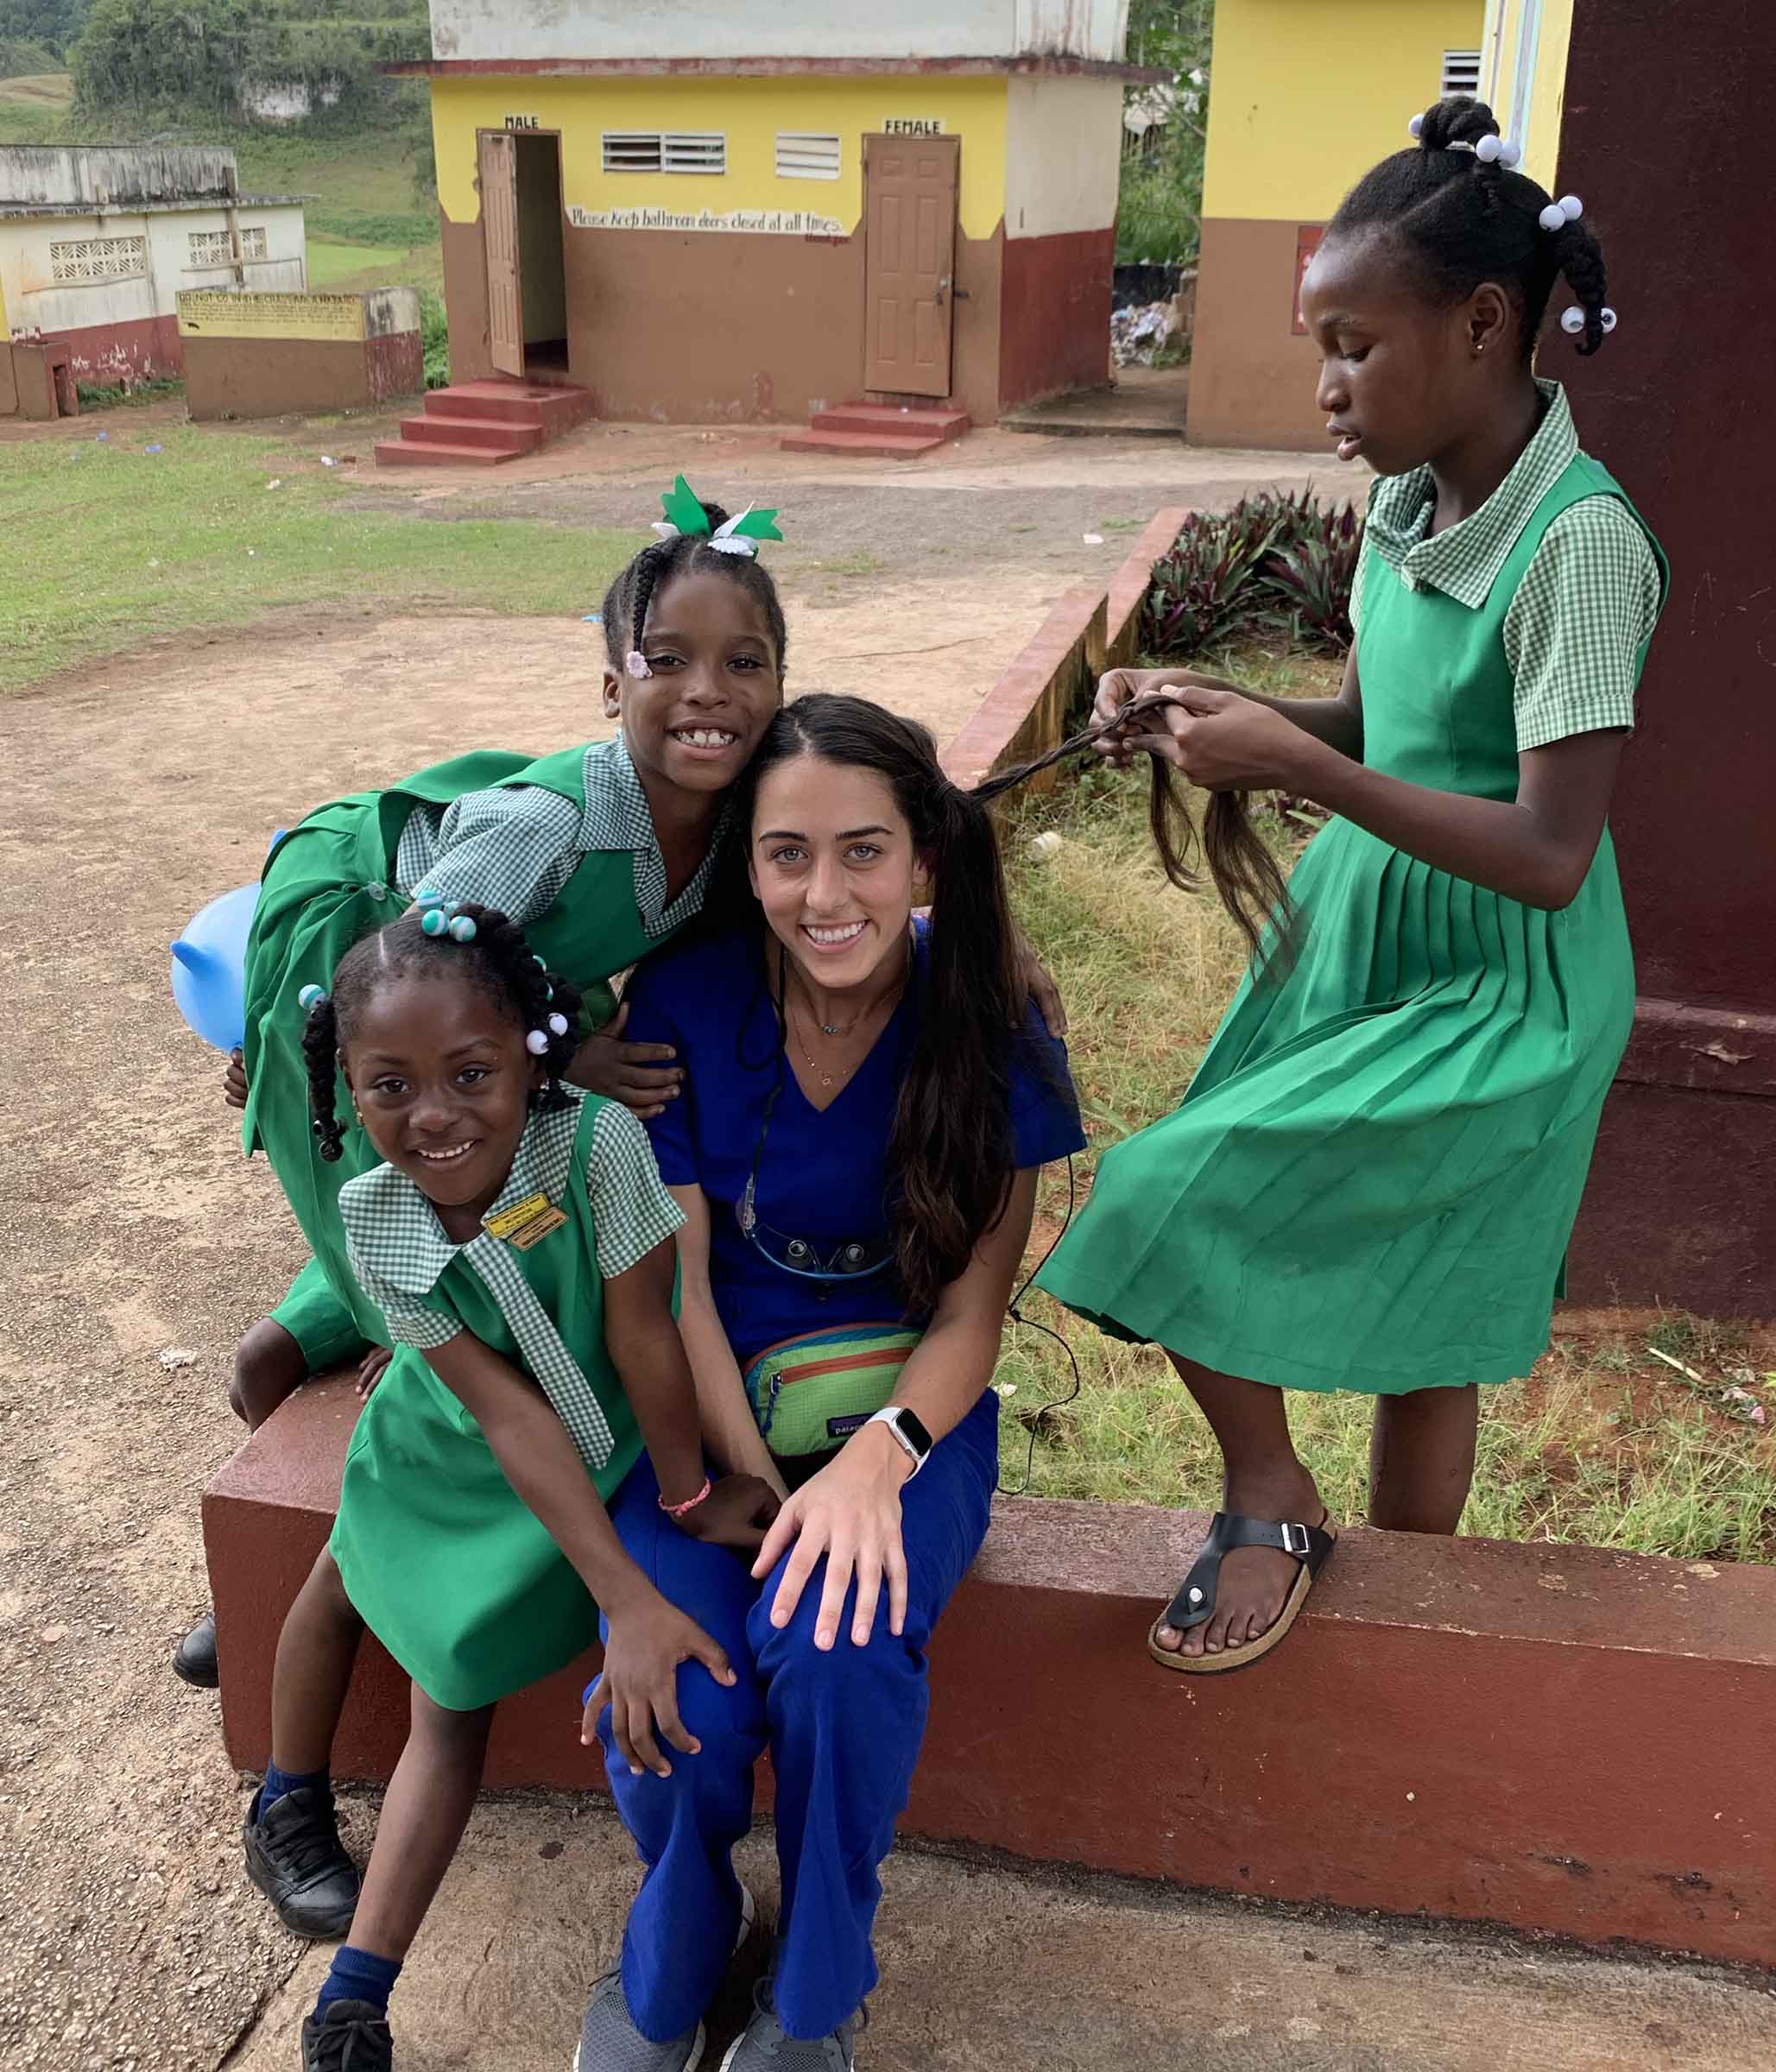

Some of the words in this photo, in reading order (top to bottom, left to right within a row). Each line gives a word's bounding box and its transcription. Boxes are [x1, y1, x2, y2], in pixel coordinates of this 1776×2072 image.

[505, 117, 539, 130] MALE
[886, 120, 940, 135] FEMALE
[572, 208, 604, 225] Please
[698, 210, 728, 229] doors
[731, 213, 765, 230] closed
[768, 213, 781, 231] at
[785, 213, 801, 231] all
